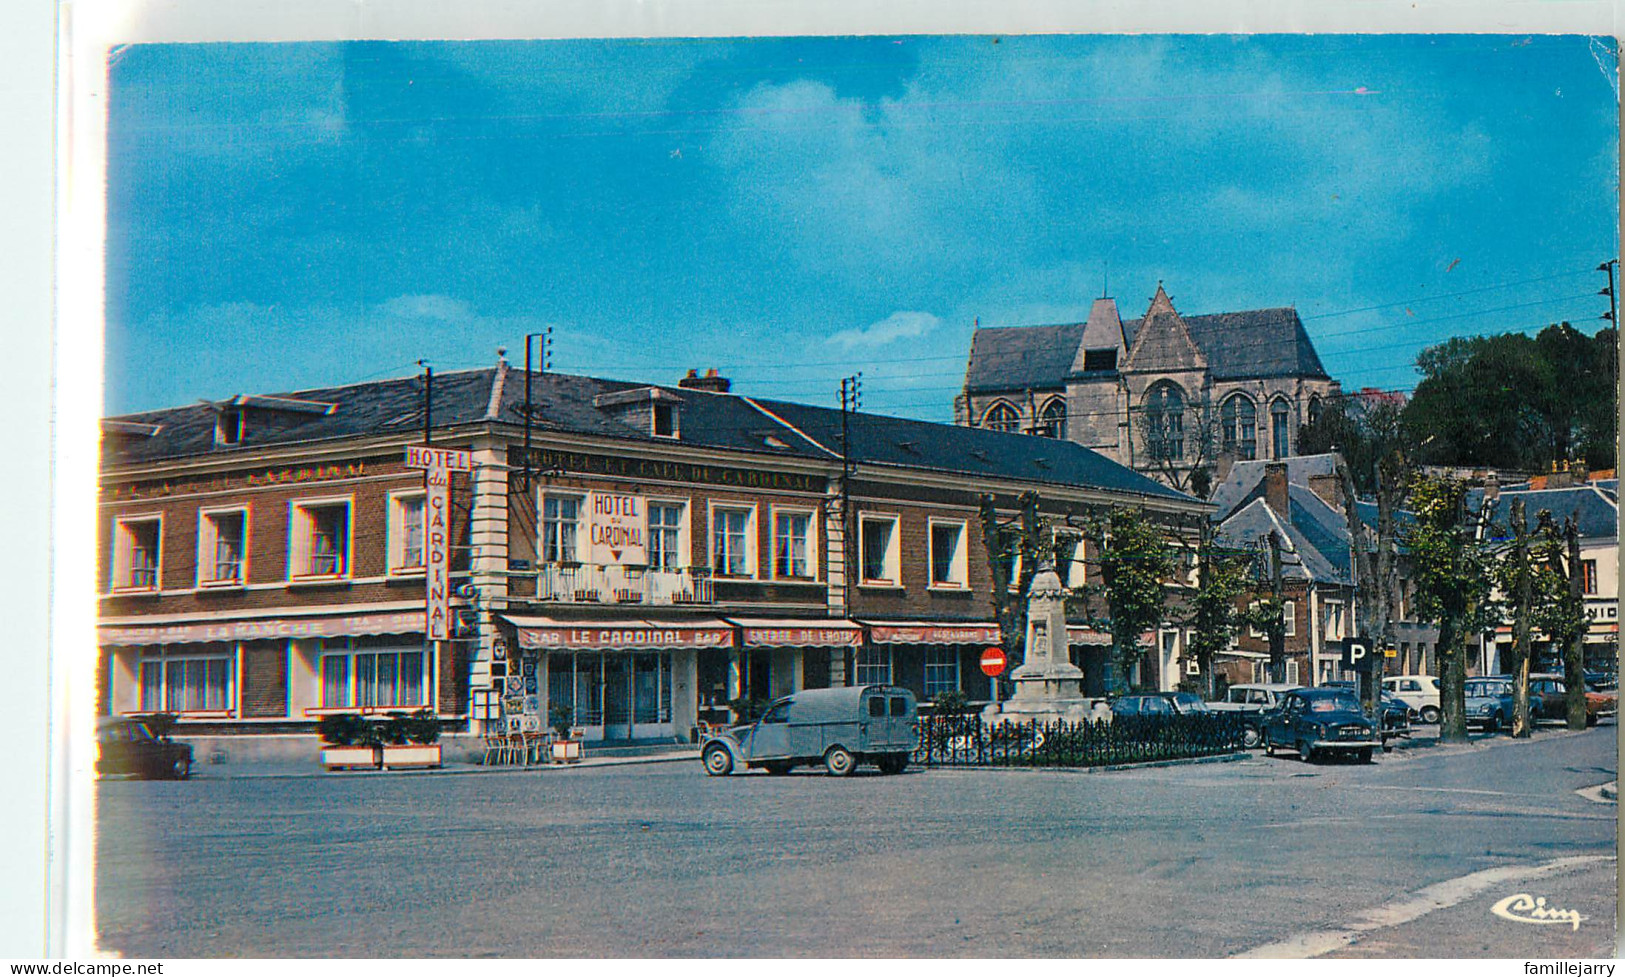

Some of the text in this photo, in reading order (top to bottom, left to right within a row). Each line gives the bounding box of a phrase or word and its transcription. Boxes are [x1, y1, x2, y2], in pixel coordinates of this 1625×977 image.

[406, 448, 468, 469] HOTEL
[428, 472, 447, 487] du
[527, 450, 589, 470] HOTEL
[722, 469, 813, 490] CARDINAL
[594, 495, 638, 516] HOTEL
[590, 523, 643, 548] CARDINAL
[431, 496, 444, 638] CARDINAL
[571, 631, 590, 644] LE
[600, 631, 683, 644] CARDINAL
[694, 632, 721, 643] BAR
[800, 630, 818, 641] DE
[1350, 644, 1366, 664] P
